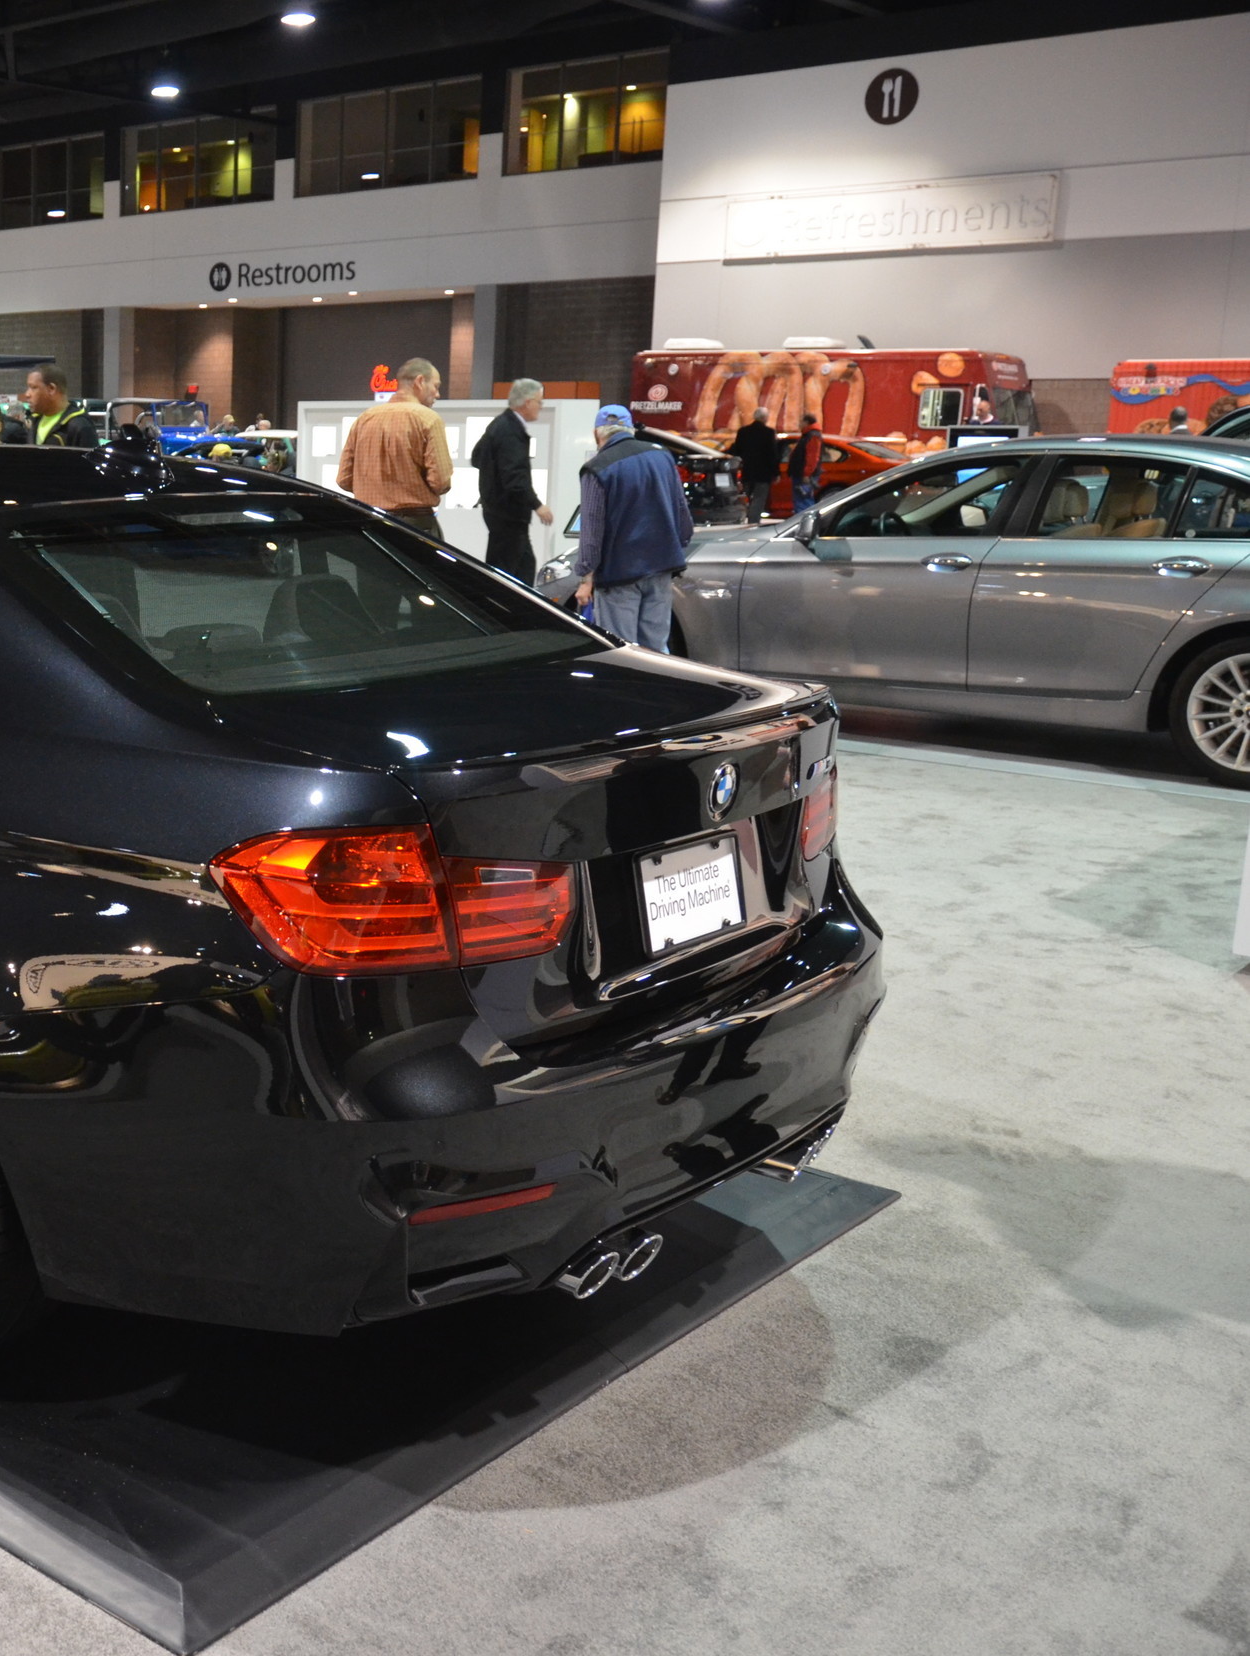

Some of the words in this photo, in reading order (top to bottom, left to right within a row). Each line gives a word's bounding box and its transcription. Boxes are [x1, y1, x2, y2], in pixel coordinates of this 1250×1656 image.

[779, 193, 1051, 242] Refreshments
[238, 261, 356, 287] Restrooms
[630, 400, 683, 411] PRETZELMAKER
[654, 874, 676, 894] The
[678, 864, 719, 887] Ultimate
[649, 897, 686, 921] Driving
[688, 882, 731, 909] Machine
